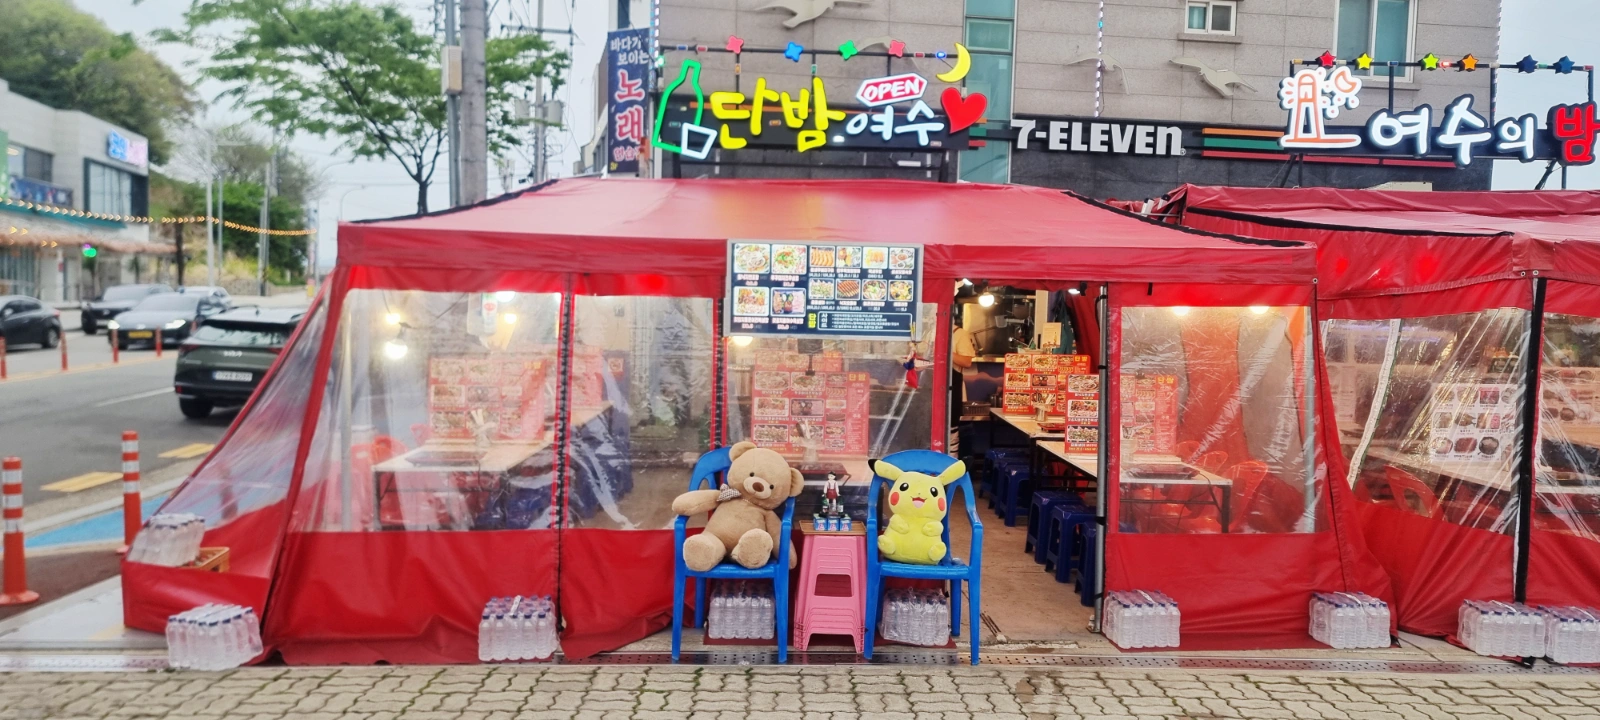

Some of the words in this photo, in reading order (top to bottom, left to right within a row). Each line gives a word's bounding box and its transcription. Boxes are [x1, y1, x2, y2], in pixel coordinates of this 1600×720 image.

[617, 49, 650, 66] 보이는
[863, 78, 920, 102] OPEN
[709, 77, 846, 153] 단밤
[845, 100, 945, 147] 여수
[1369, 96, 1536, 166] 여수의
[1553, 102, 1600, 163] 밤
